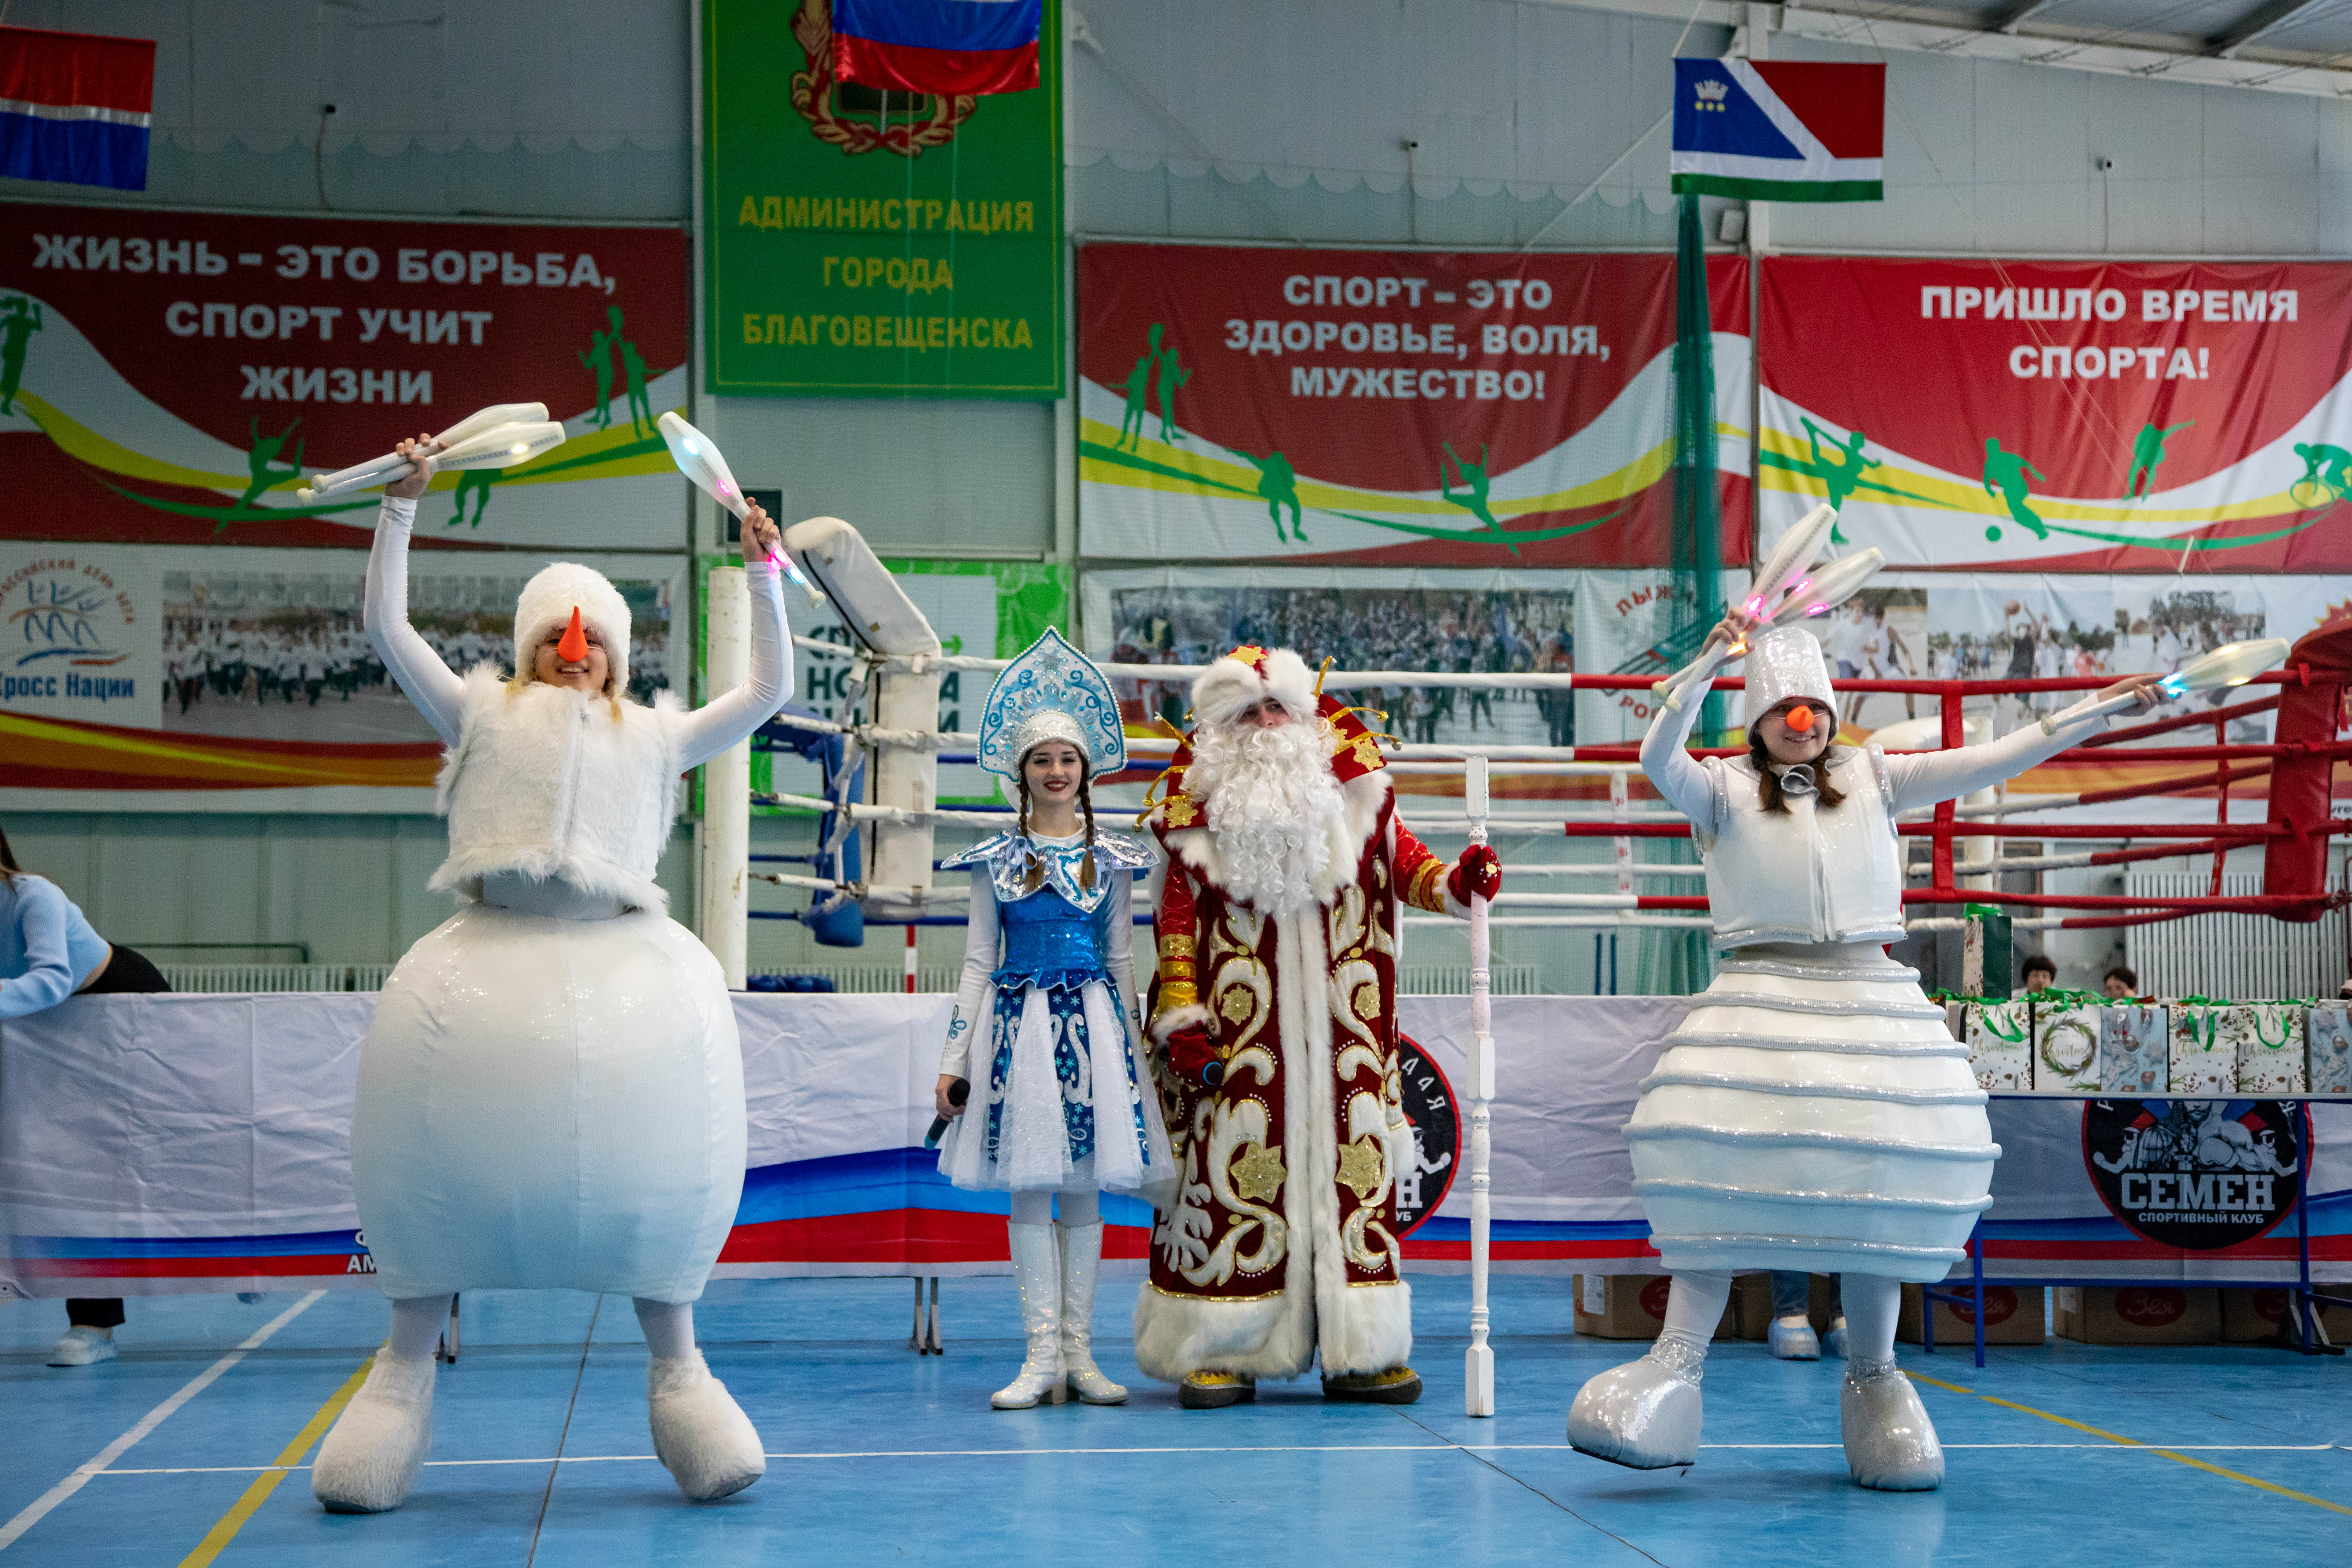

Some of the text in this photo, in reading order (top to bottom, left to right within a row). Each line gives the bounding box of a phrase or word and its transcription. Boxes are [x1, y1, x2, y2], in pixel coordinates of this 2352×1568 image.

[739, 195, 1034, 235] АДМИНИСТРАЦИЯ
[33, 233, 228, 276] ЖИЗНЬ
[275, 244, 380, 282] ЭТО
[398, 249, 616, 296] БОРЬБА,
[823, 256, 954, 294] ГОРОДА
[1283, 274, 1428, 307] СПОРТ
[1467, 278, 1553, 310] ЭТО
[1921, 285, 2298, 323] ПРИШЛО ВРЕМЯ
[165, 301, 493, 346] СПОРТ УЧИТ
[743, 313, 1033, 353] БЛАГОВЕЩЕНСКА
[1225, 318, 1610, 362] ЗДОРОВЬЕ, ВОЛЯ,
[2009, 345, 2210, 380] СПОРТА!
[240, 365, 433, 404] ЖИЗНИ
[1291, 367, 1545, 401] МУЖЕСТВО!
[0, 672, 57, 701] росс
[2121, 1172, 2275, 1211] СЕМЕН
[2138, 1211, 2265, 1224] СПОРТИВНЫЙ КЛУБ
